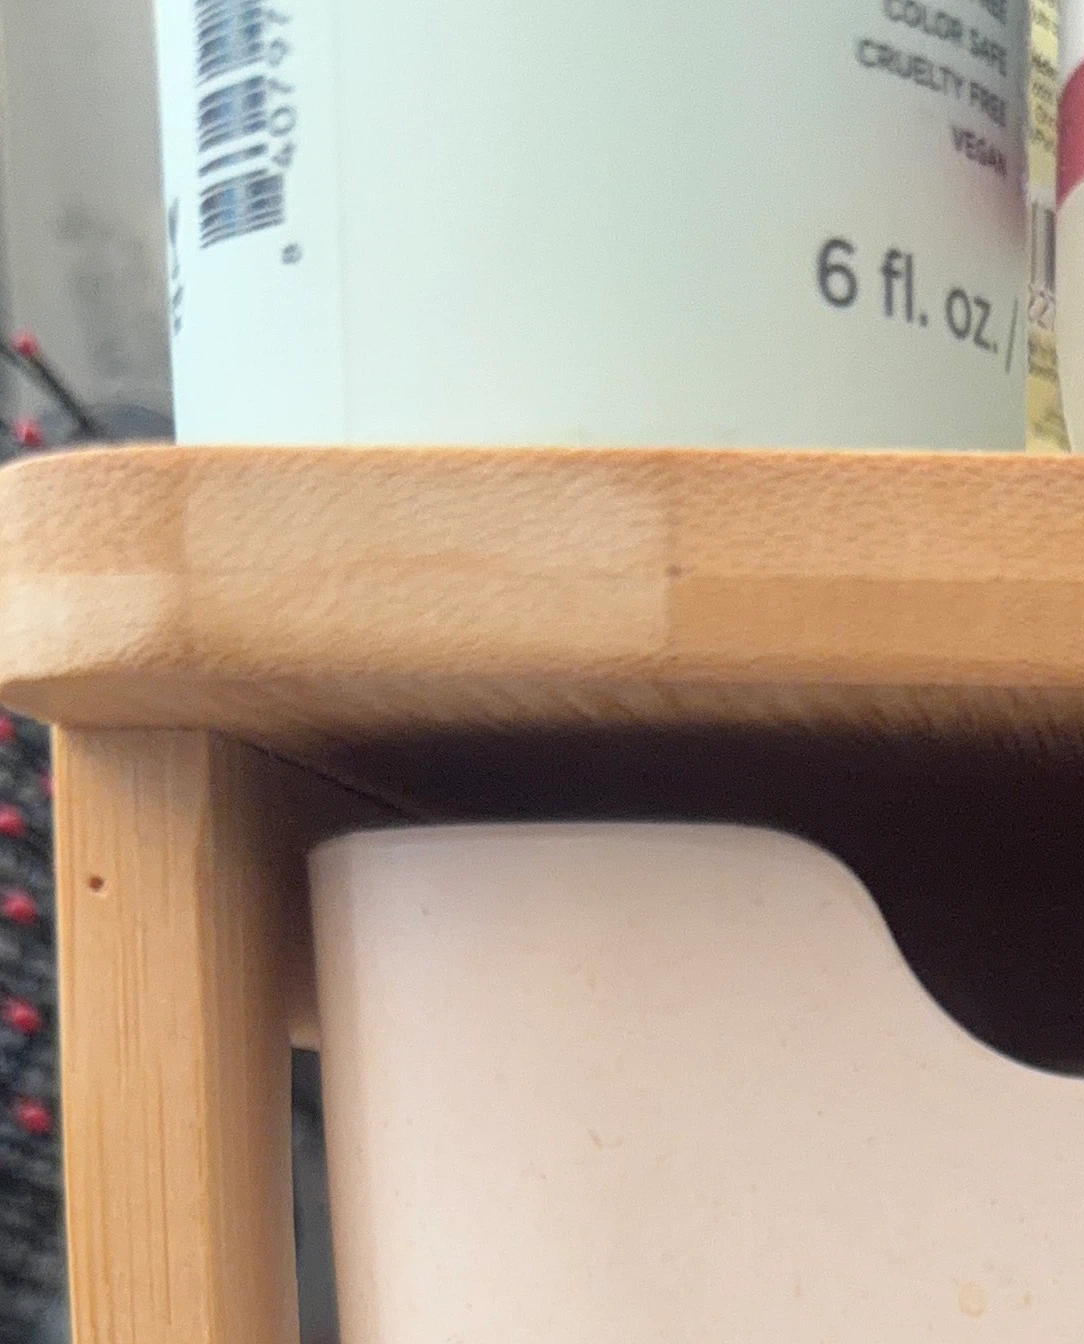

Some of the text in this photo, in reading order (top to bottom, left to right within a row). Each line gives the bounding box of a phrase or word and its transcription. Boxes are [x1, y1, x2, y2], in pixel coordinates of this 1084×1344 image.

[854, 38, 965, 99] CRUELTY
[969, 80, 1007, 128] FREE
[969, 27, 1007, 78] SAFE
[952, 124, 1008, 178] VEGAN
[817, 236, 859, 309] 6
[881, 248, 929, 325] fl.
